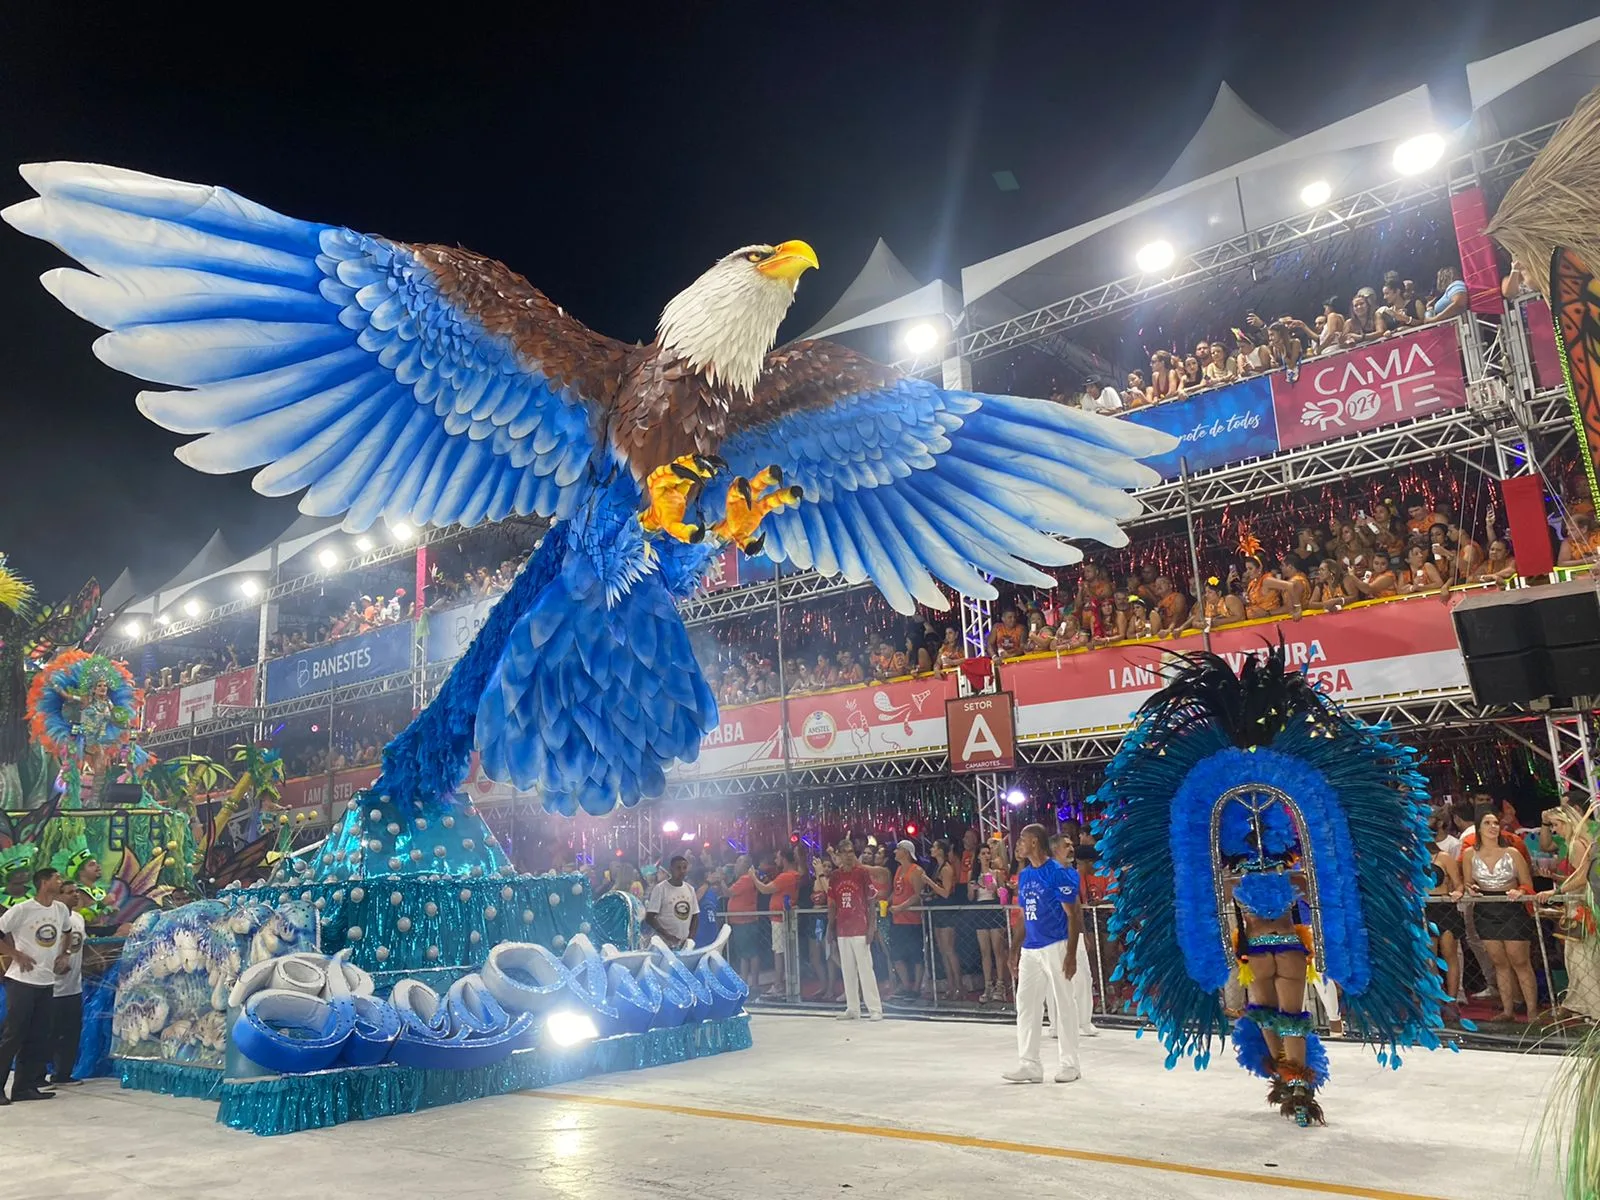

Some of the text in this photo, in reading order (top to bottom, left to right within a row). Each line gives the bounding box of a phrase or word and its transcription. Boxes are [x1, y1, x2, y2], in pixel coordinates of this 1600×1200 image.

[1314, 343, 1434, 396] CAMA
[1209, 419, 1225, 437] de
[1226, 411, 1261, 432] todos
[312, 647, 371, 679] BANESTES
[1109, 668, 1116, 690] I
[1121, 663, 1156, 689] AM
[963, 700, 993, 712] SETOR
[808, 725, 832, 734] AMSTEL
[962, 713, 1002, 761] A
[965, 760, 1001, 769] CAMAROTES
[307, 787, 321, 804] AM
[1025, 911, 1038, 921] TA
